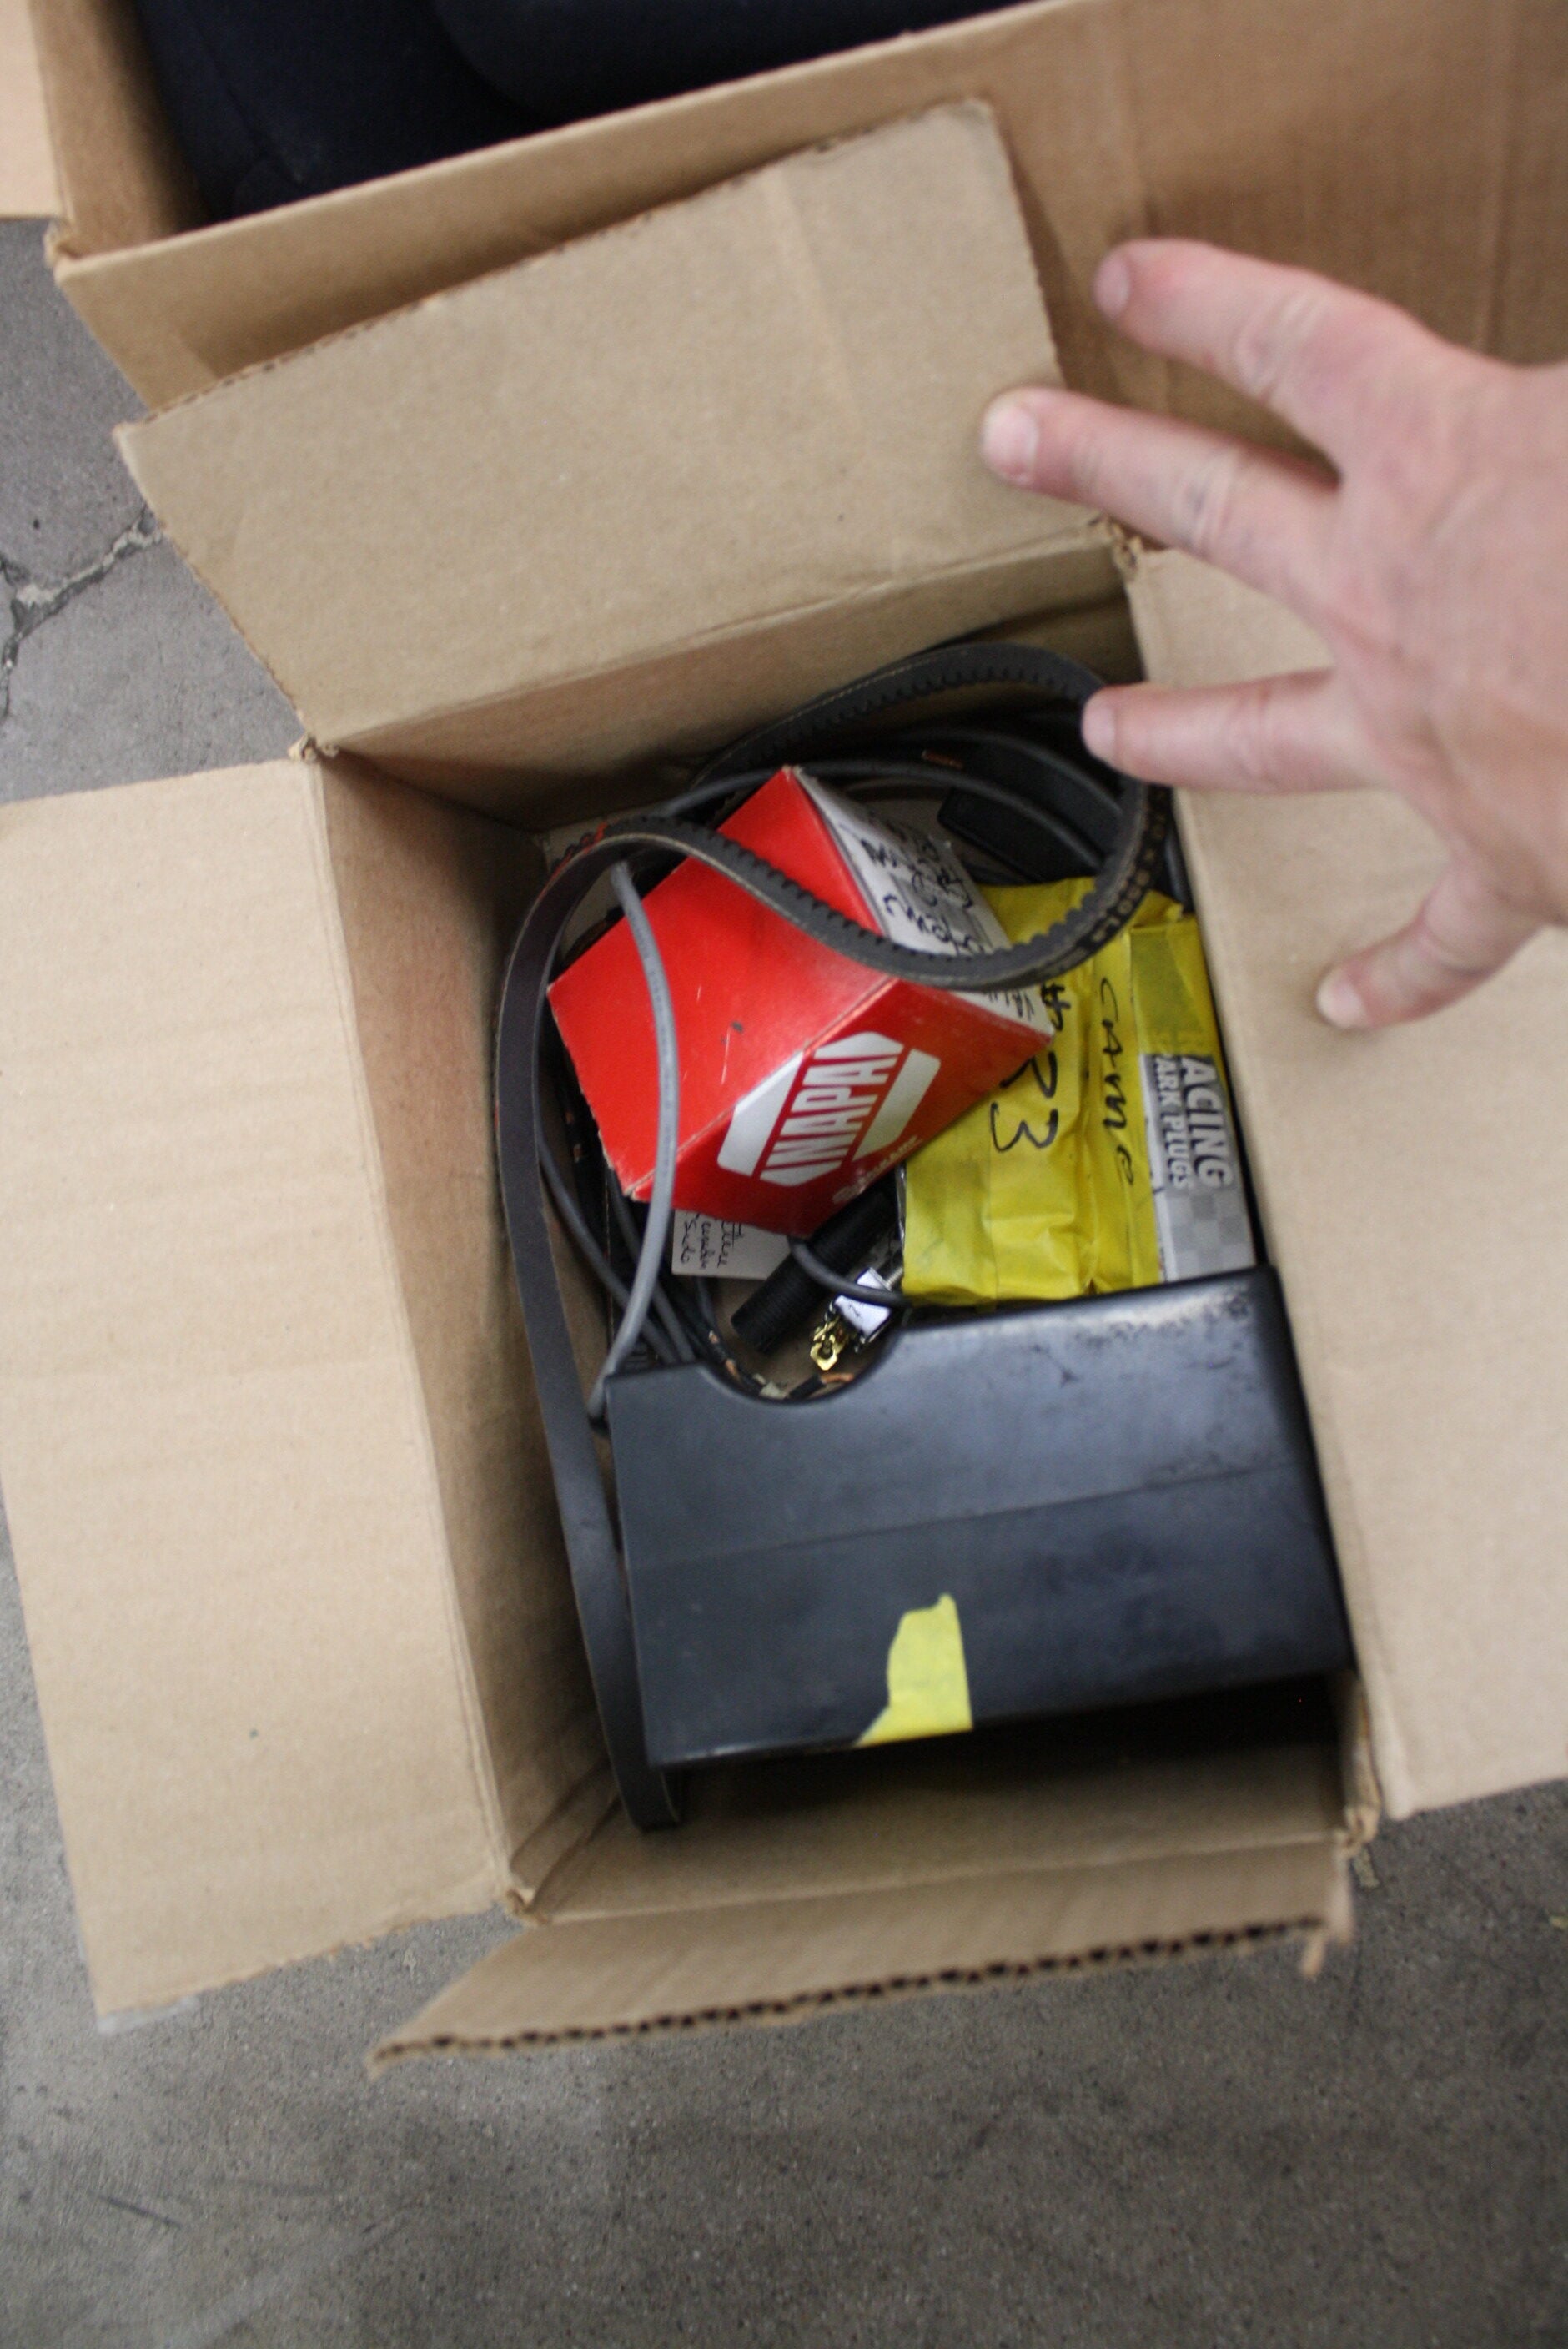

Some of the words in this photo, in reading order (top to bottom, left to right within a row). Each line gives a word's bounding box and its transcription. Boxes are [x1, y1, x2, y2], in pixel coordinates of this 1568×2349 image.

[765, 1054, 899, 1168] NAPA
[1154, 1054, 1181, 1108] ARK
[1180, 1054, 1235, 1189] ACING
[1162, 1113, 1192, 1189] PLUGS
